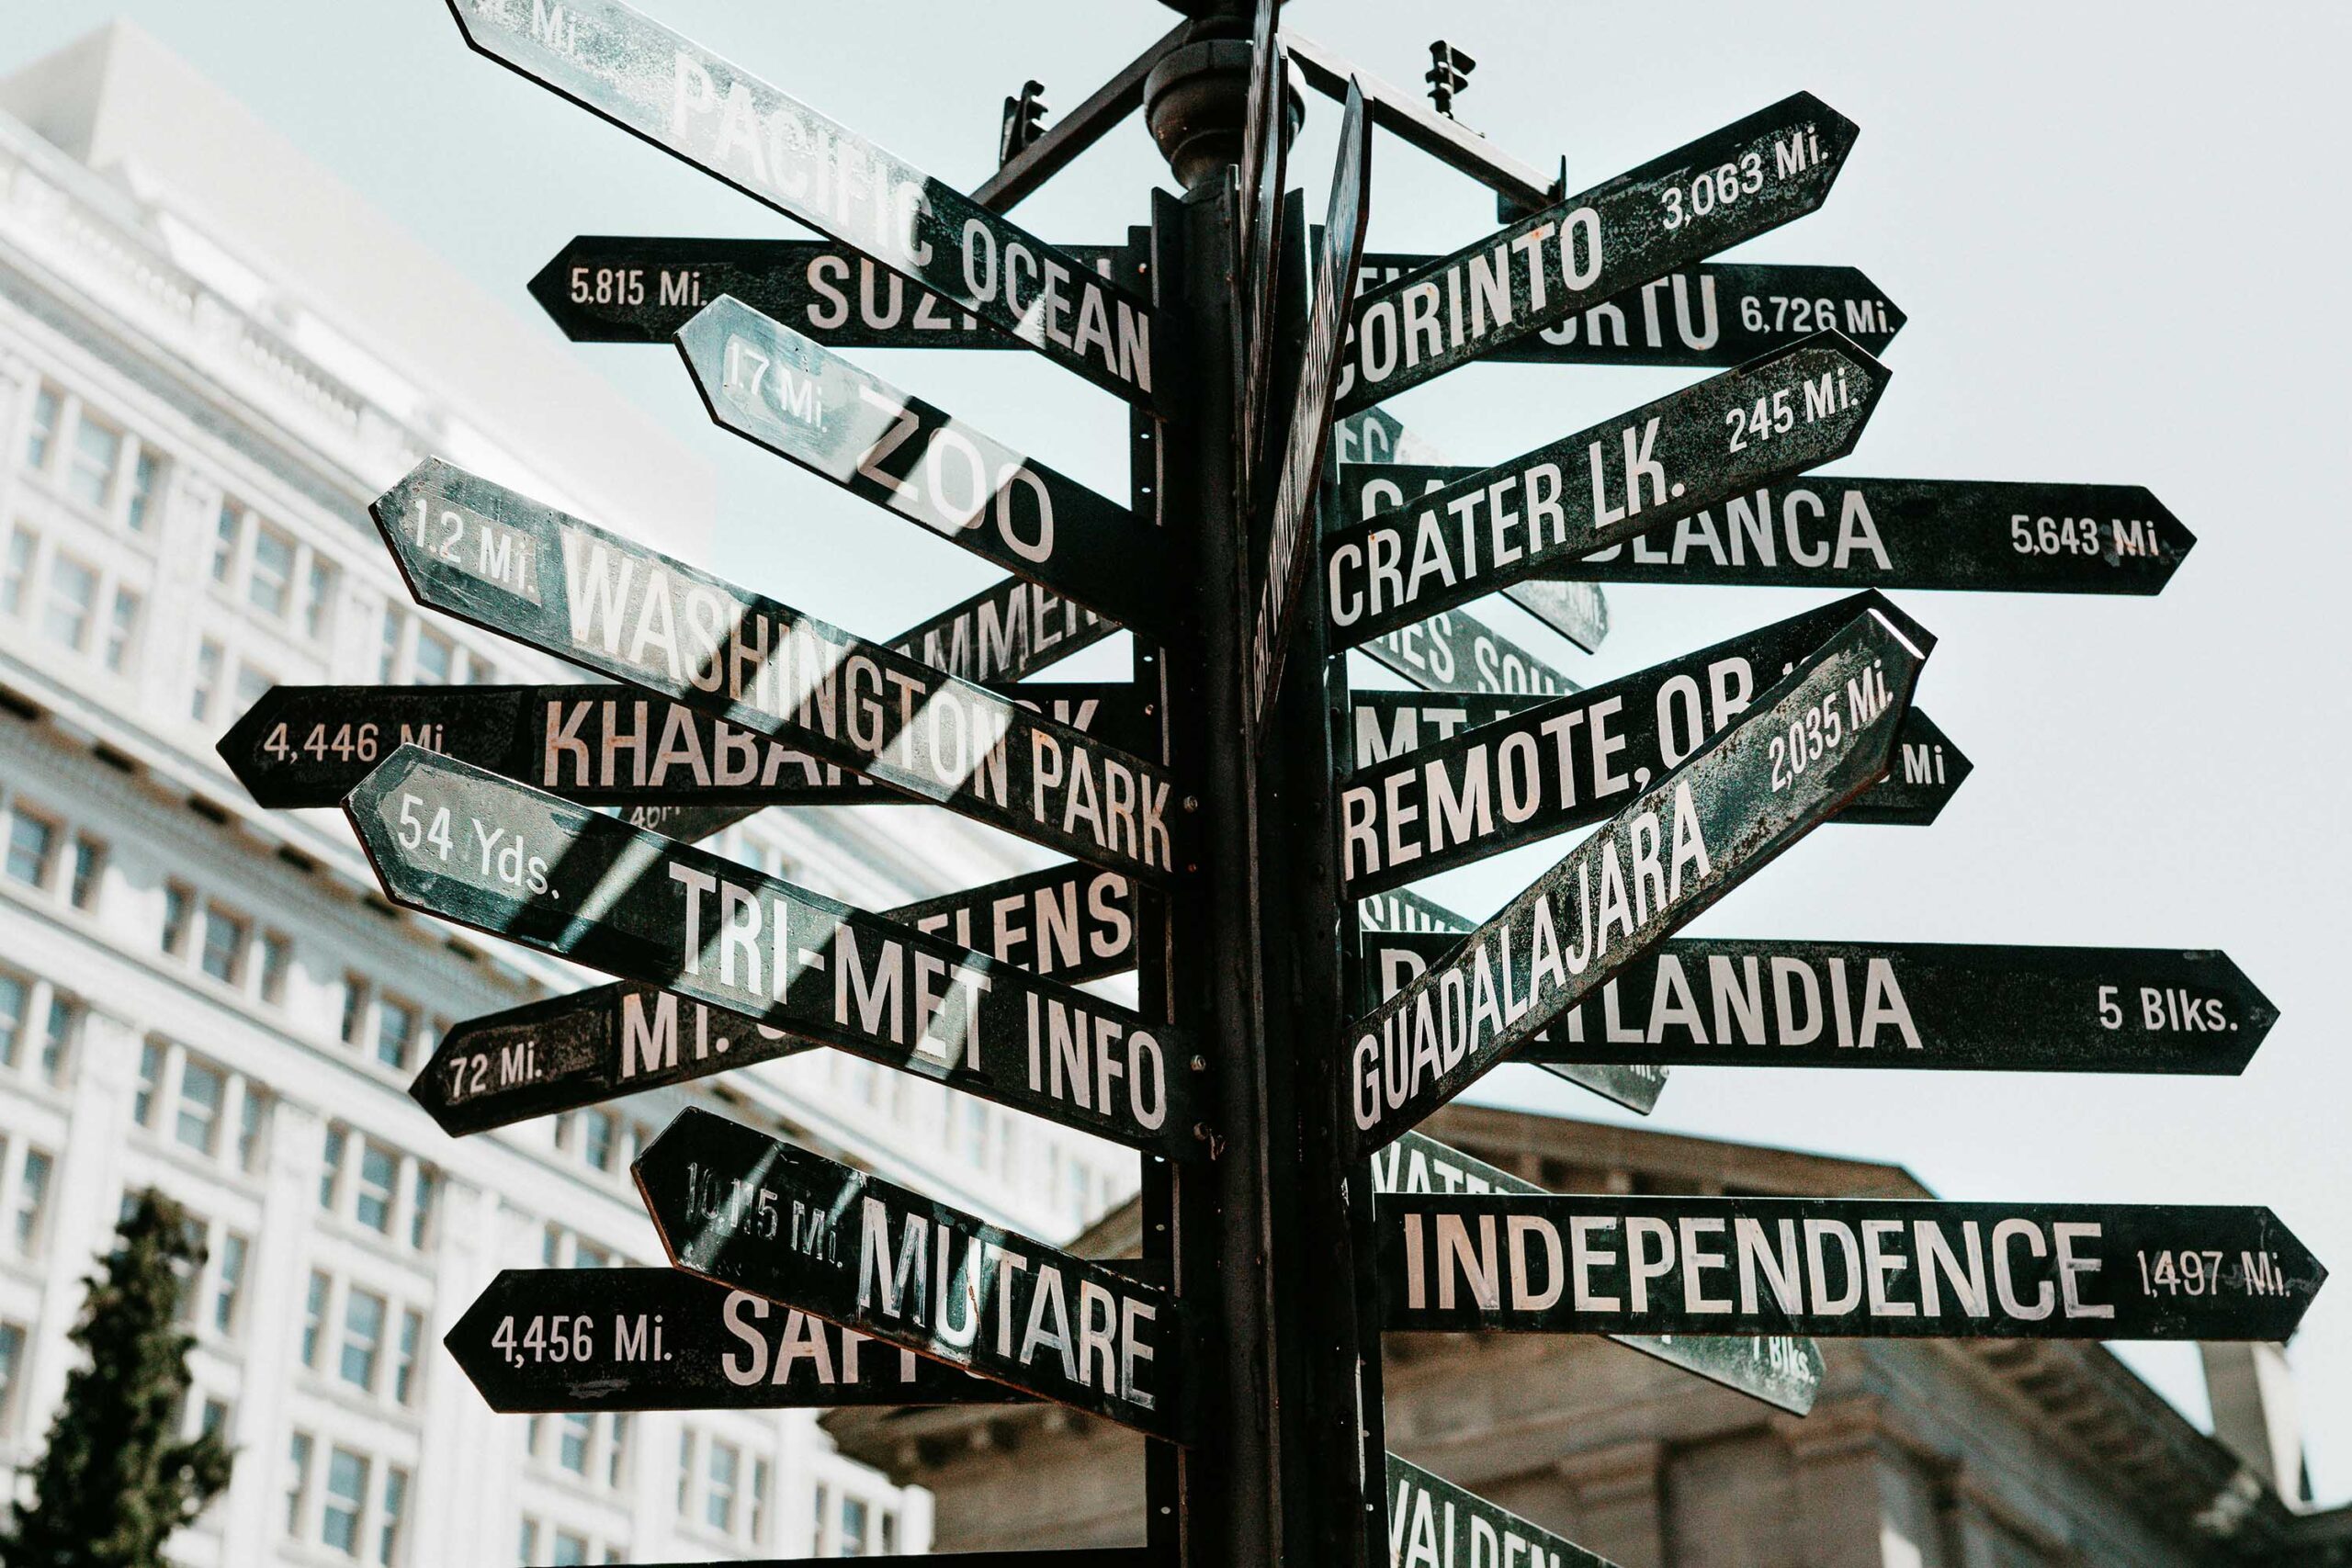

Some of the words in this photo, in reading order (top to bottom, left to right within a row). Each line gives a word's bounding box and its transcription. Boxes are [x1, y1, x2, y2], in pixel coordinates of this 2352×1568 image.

[668, 50, 933, 267] PACIFIC
[962, 219, 1152, 393] OCEAN
[1659, 152, 1763, 231] 3,063
[1774, 127, 1829, 175] Mi.
[571, 267, 645, 308] 5,815
[659, 271, 708, 308] Mi.
[1740, 296, 1837, 333] 6,726
[1847, 299, 1895, 334] Mi.
[779, 378, 828, 434] Mi.
[1724, 389, 1794, 453] 245
[1804, 368, 1859, 423] Mi.
[856, 384, 1055, 563] ZOO
[479, 525, 536, 594] Mi.
[1329, 463, 1566, 627] CRATER
[1589, 416, 1685, 529] LK.
[2011, 513, 2100, 557] 5,643
[263, 722, 379, 765] 4,446
[560, 525, 1009, 808] WASHINGTON
[1030, 728, 1172, 874] PARK
[1769, 692, 1842, 794] 2,035
[1847, 659, 1894, 731] Mi.
[397, 794, 455, 862] 54
[471, 818, 560, 899] Yds.
[669, 861, 991, 1070] TRI-MET
[1026, 990, 1167, 1131] INFO
[1353, 781, 1713, 1131] GUADALAJARA
[2098, 986, 2123, 1031] 5
[2141, 987, 2239, 1032] Blks.
[448, 1053, 488, 1099] 72
[501, 1041, 543, 1087] Mi.
[790, 1200, 843, 1269] Mi.
[1404, 1213, 2115, 1321] INDEPENDENCE
[2136, 1250, 2222, 1300] 1,497
[2244, 1250, 2291, 1299] Mi.
[490, 1314, 594, 1370] 4,456
[615, 1314, 673, 1362] Mi.
[859, 1195, 1159, 1412] MUTARE
